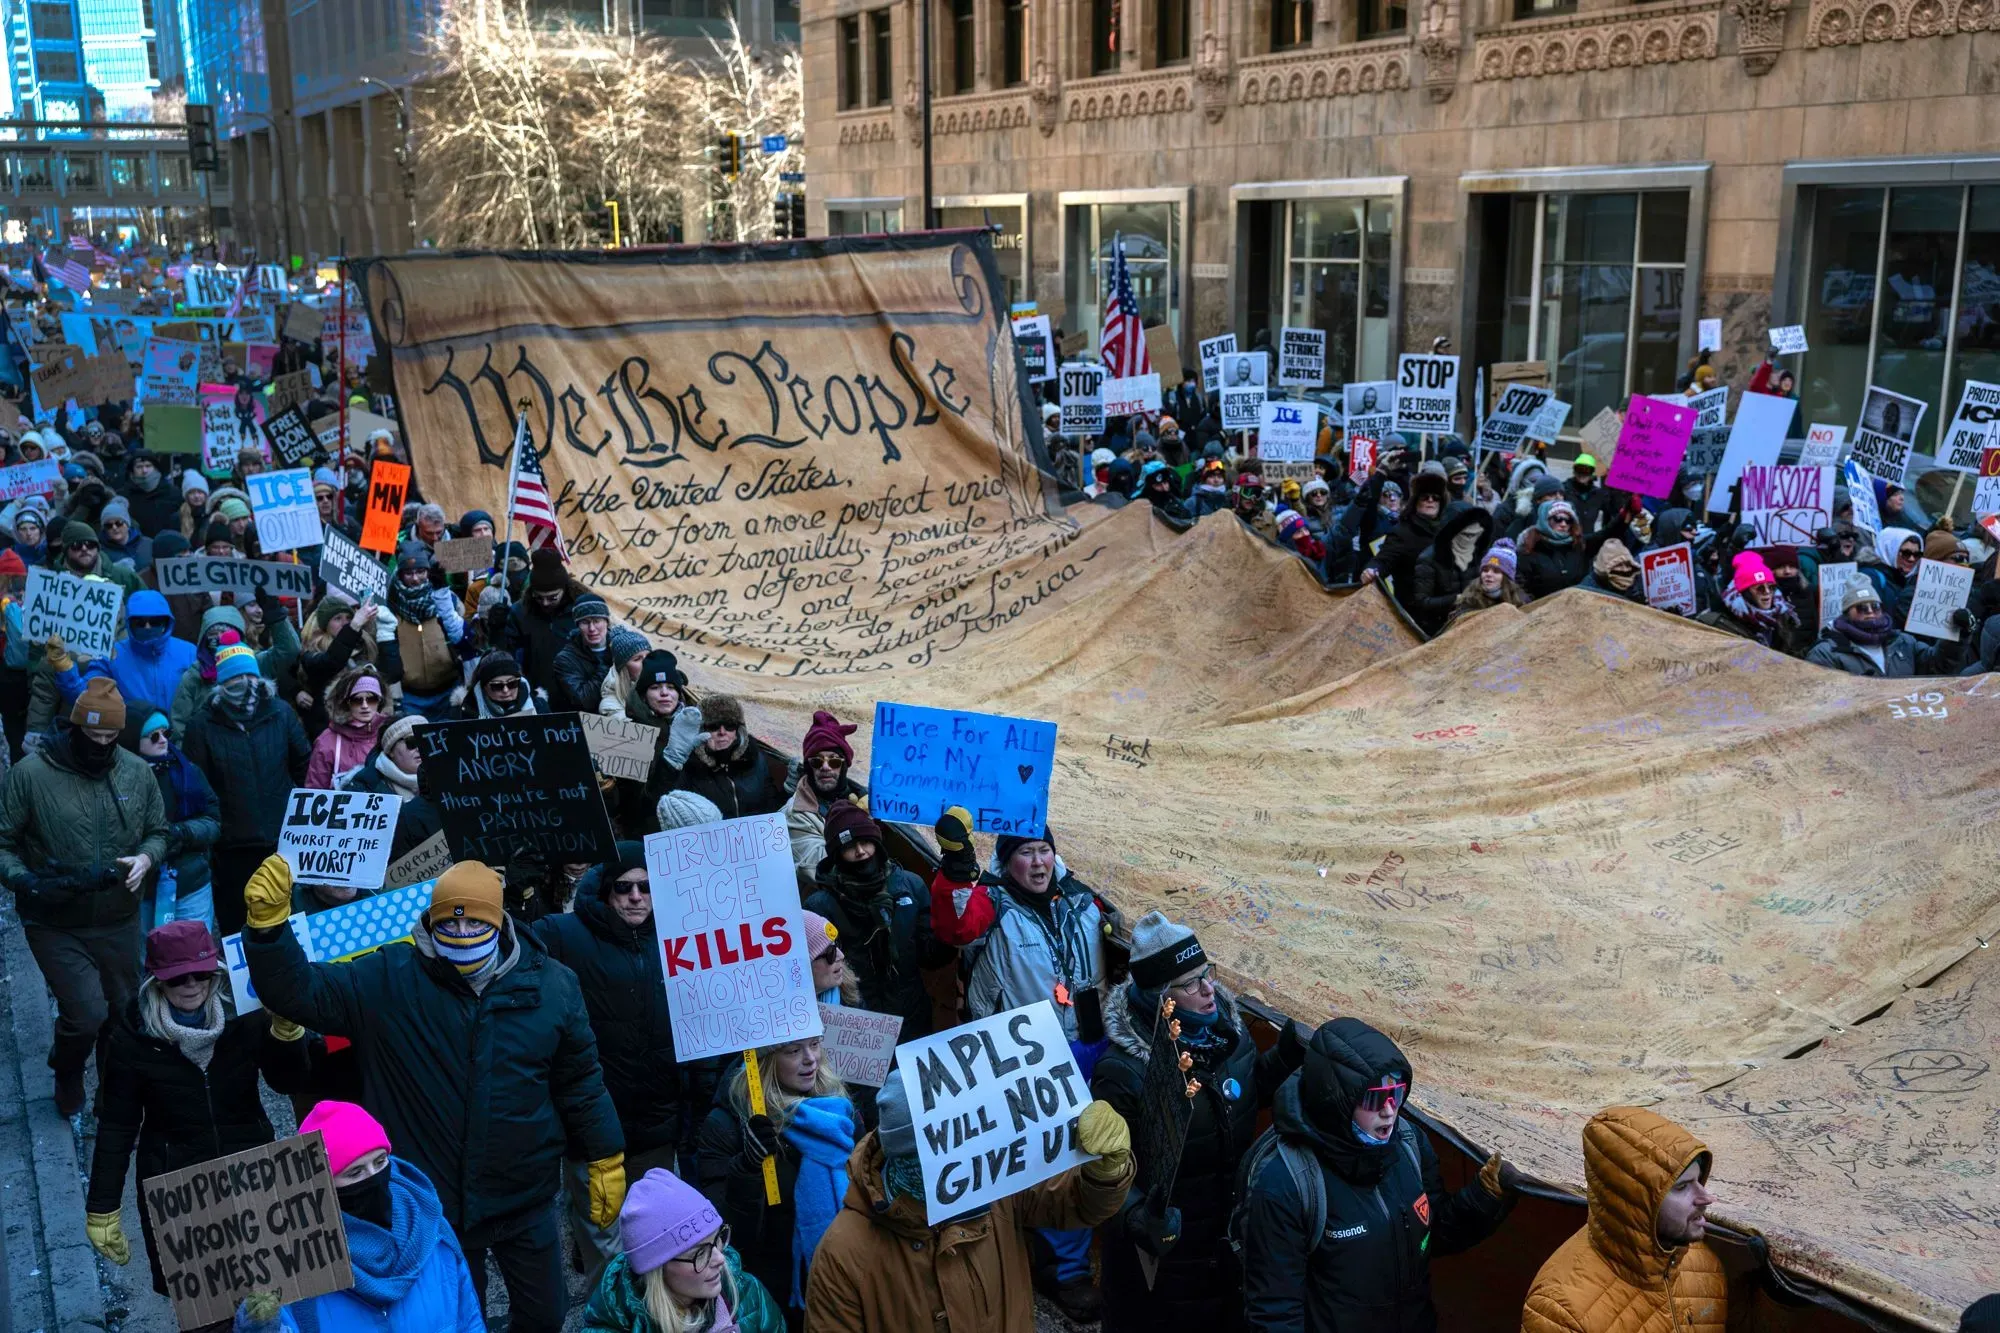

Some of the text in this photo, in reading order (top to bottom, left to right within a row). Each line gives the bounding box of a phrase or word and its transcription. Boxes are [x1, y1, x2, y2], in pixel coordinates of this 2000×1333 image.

[991, 233, 1022, 249] LDING
[1202, 337, 1235, 359] ICE OUT
[1284, 331, 1323, 345] GENERAL
[1284, 343, 1320, 357] STRIKE
[1063, 371, 1103, 397] STOP
[1282, 368, 1323, 380] JUSTICE
[1402, 358, 1454, 390] STOP
[423, 343, 612, 469] We
[708, 332, 971, 464] People
[1063, 405, 1074, 416] ICE
[1104, 399, 1145, 417] STOP ICE
[1224, 394, 1251, 405] JUSTICE
[1400, 396, 1451, 412] ICE TERROR
[1500, 388, 1547, 417] STOP
[1966, 386, 2000, 406] PROTES
[268, 408, 301, 437] FREE
[1272, 406, 1302, 424] ICE
[1348, 417, 1377, 430] JUSTICE
[1398, 412, 1450, 423] NOW!
[1486, 419, 1528, 435] ICE TERROR
[275, 425, 310, 450] DON
[283, 438, 317, 465] LEMON
[1481, 431, 1521, 445] NOW!
[1810, 430, 1834, 442] NO
[1854, 431, 1909, 467] JUSTICE
[1953, 430, 1968, 447] IS
[1264, 464, 1314, 479] ICE OUT!
[1877, 462, 1904, 484] GOOD
[248, 471, 314, 512] ICE
[372, 482, 403, 515] MN
[566, 476, 626, 518] the
[631, 464, 732, 515] United
[1741, 464, 1822, 512] MINNESOTA
[258, 510, 318, 549] OUT
[621, 517, 661, 551] to
[655, 513, 735, 559] form
[830, 477, 935, 541] perfect
[323, 545, 348, 572] MAKE
[328, 531, 388, 585] IMMIGRANTS
[581, 554, 710, 588] domestic
[883, 506, 988, 560] provide
[164, 560, 311, 600] ICE GTFO MN
[339, 573, 364, 596] GREA
[351, 564, 388, 600] AMERICA
[624, 588, 728, 609] common
[876, 534, 988, 584] promote
[800, 584, 852, 616] and
[871, 556, 971, 599] secure
[1922, 564, 1966, 589] MN nice
[39, 574, 116, 611] THEY ARE
[984, 569, 1030, 618] for
[1657, 582, 1682, 595] OUT OF
[1917, 587, 1936, 601] and
[31, 594, 114, 632] ALL OUR
[857, 614, 893, 639] do
[1910, 603, 1942, 629] FUCK
[28, 616, 112, 652] CHILDREN
[908, 638, 937, 670] of
[423, 721, 583, 759] If you're not
[581, 713, 656, 745] RACISM
[880, 706, 1045, 753] Here For ALL
[904, 741, 982, 780] of My
[1108, 733, 1153, 760] Fuck
[457, 751, 537, 784] ANGRY
[879, 761, 1000, 803] Community
[286, 791, 383, 831] ICE is
[440, 782, 590, 813] then you're not
[351, 812, 388, 831] THE
[479, 808, 564, 834] PAYING
[976, 805, 1038, 835] Fear!
[338, 837, 353, 849] OF
[357, 837, 379, 850] THE
[461, 829, 599, 859] ATTENTION
[389, 839, 450, 884] CORPORAT
[676, 863, 765, 932] ICE
[663, 916, 793, 978] KILLS
[677, 958, 787, 1016] MOMS
[676, 996, 811, 1056] NURSES
[819, 1005, 900, 1039] inneapolis,
[836, 1029, 885, 1050] HEAR
[834, 1050, 889, 1083] VOICE
[916, 1014, 1045, 1114] MPLS
[922, 1061, 1078, 1157] WILL NOT
[147, 1140, 327, 1226] YOU PICKED THE
[935, 1136, 1028, 1206] GIVE
[163, 1187, 326, 1265] WRONG CITY
[670, 1218, 701, 1247] ICE
[166, 1227, 344, 1302] TO MESS WITH
